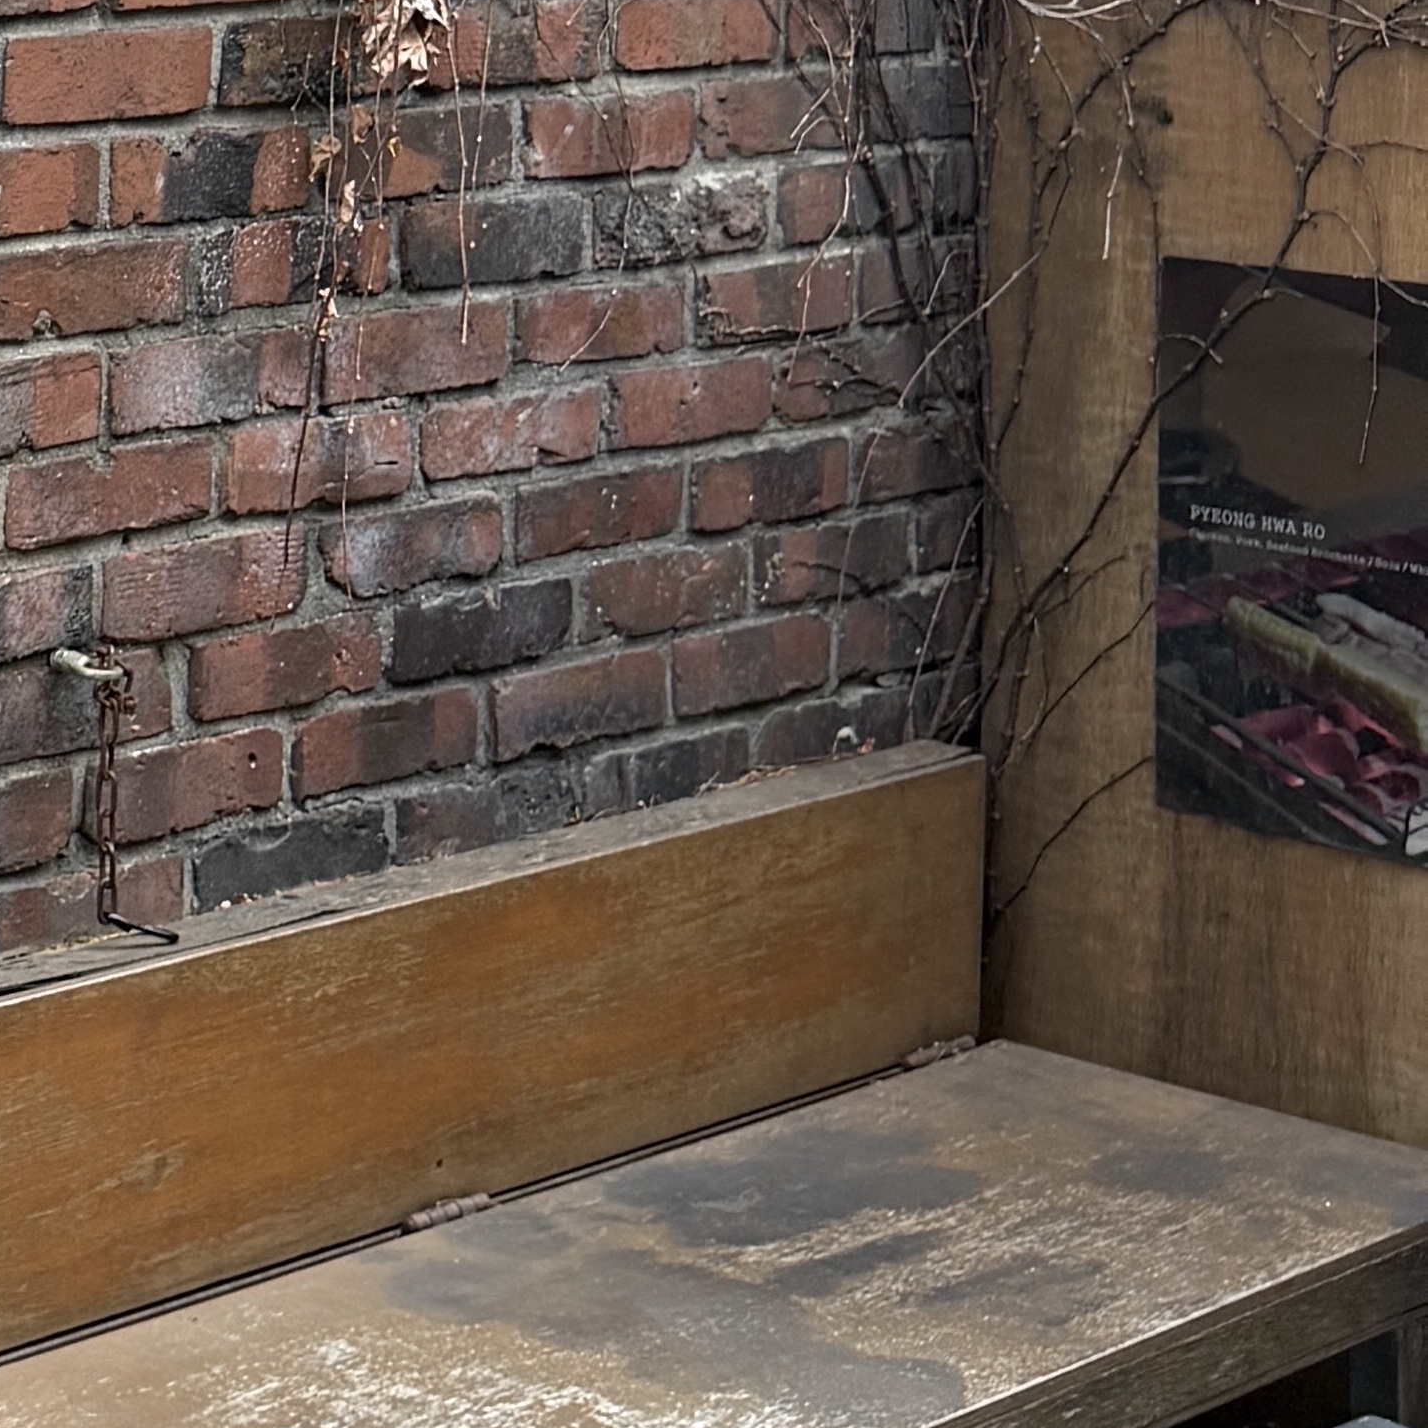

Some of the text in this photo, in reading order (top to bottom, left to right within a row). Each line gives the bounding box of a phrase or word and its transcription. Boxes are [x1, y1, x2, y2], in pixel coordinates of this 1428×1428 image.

[1190, 503, 1326, 541] PYEONG HWA RO
